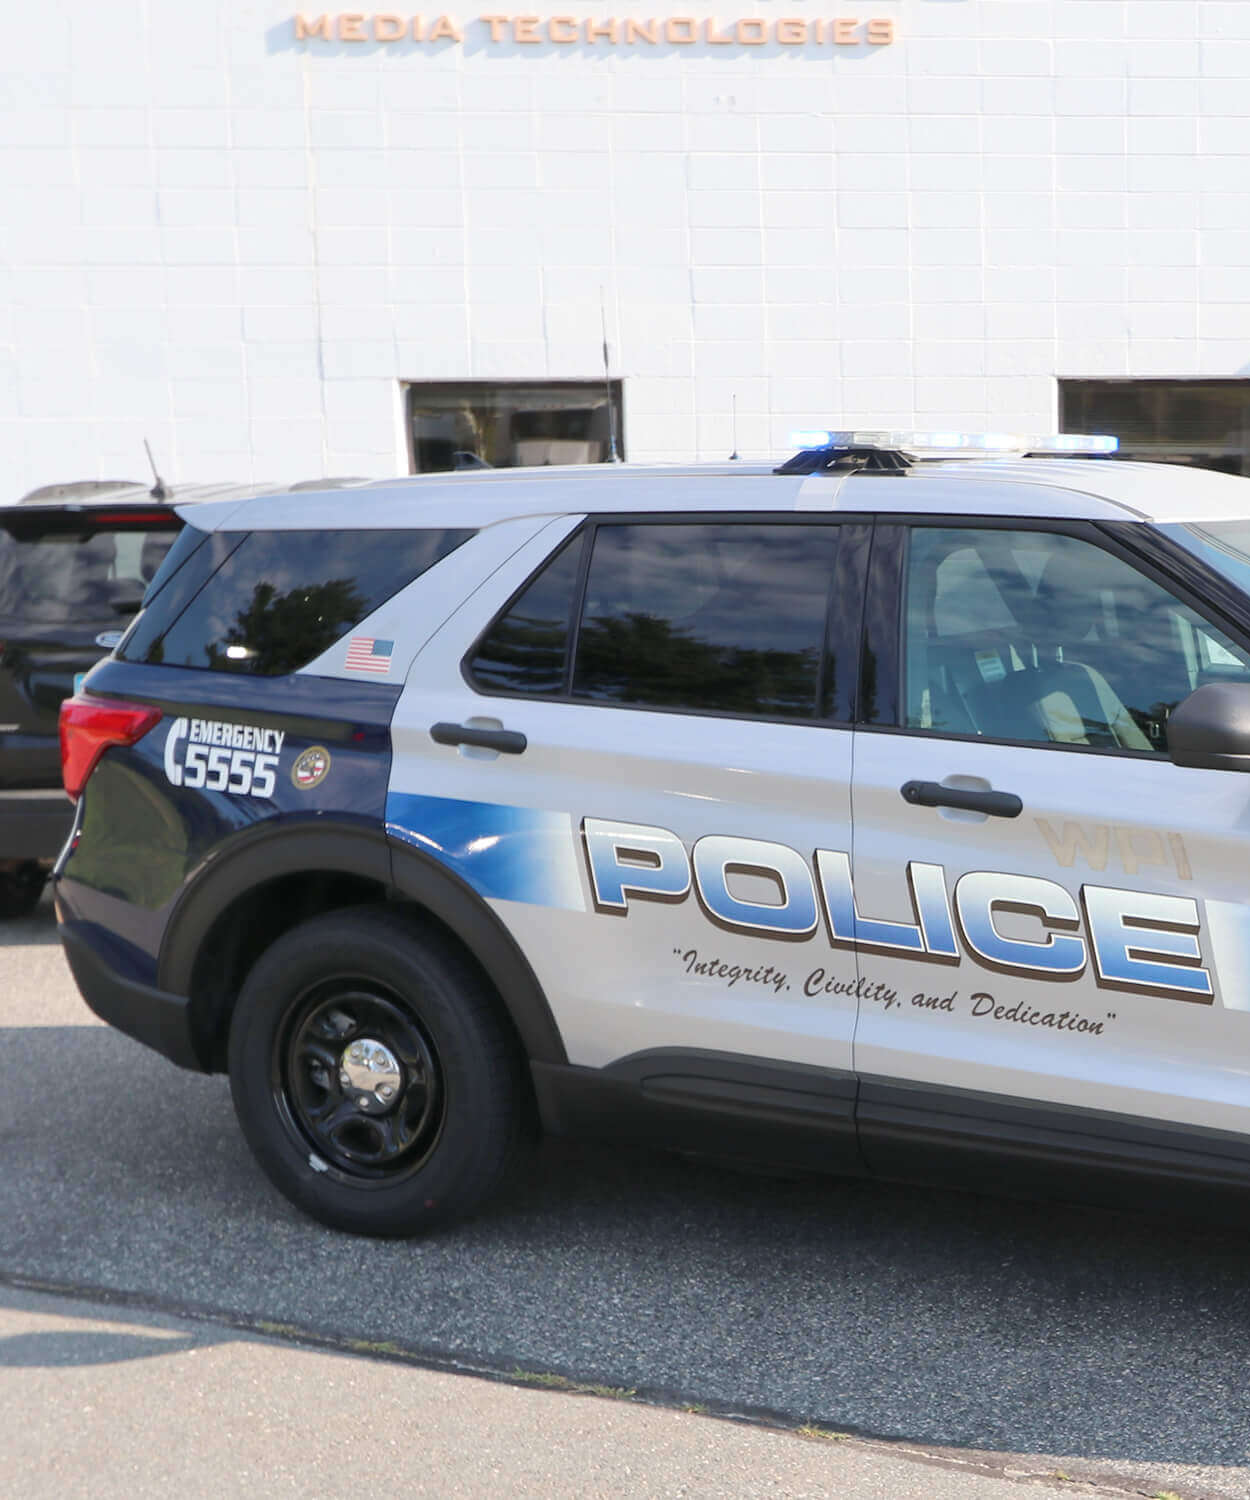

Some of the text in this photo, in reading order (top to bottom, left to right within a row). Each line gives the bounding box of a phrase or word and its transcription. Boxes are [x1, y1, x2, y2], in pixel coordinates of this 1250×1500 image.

[295, 14, 894, 46] MEDIA TECHNOLOGIES
[190, 718, 285, 754] EMERGENCY
[184, 743, 279, 799] 5555
[1034, 817, 1193, 881] WPI
[580, 816, 1214, 1004] POLICE
[911, 990, 959, 1012] and
